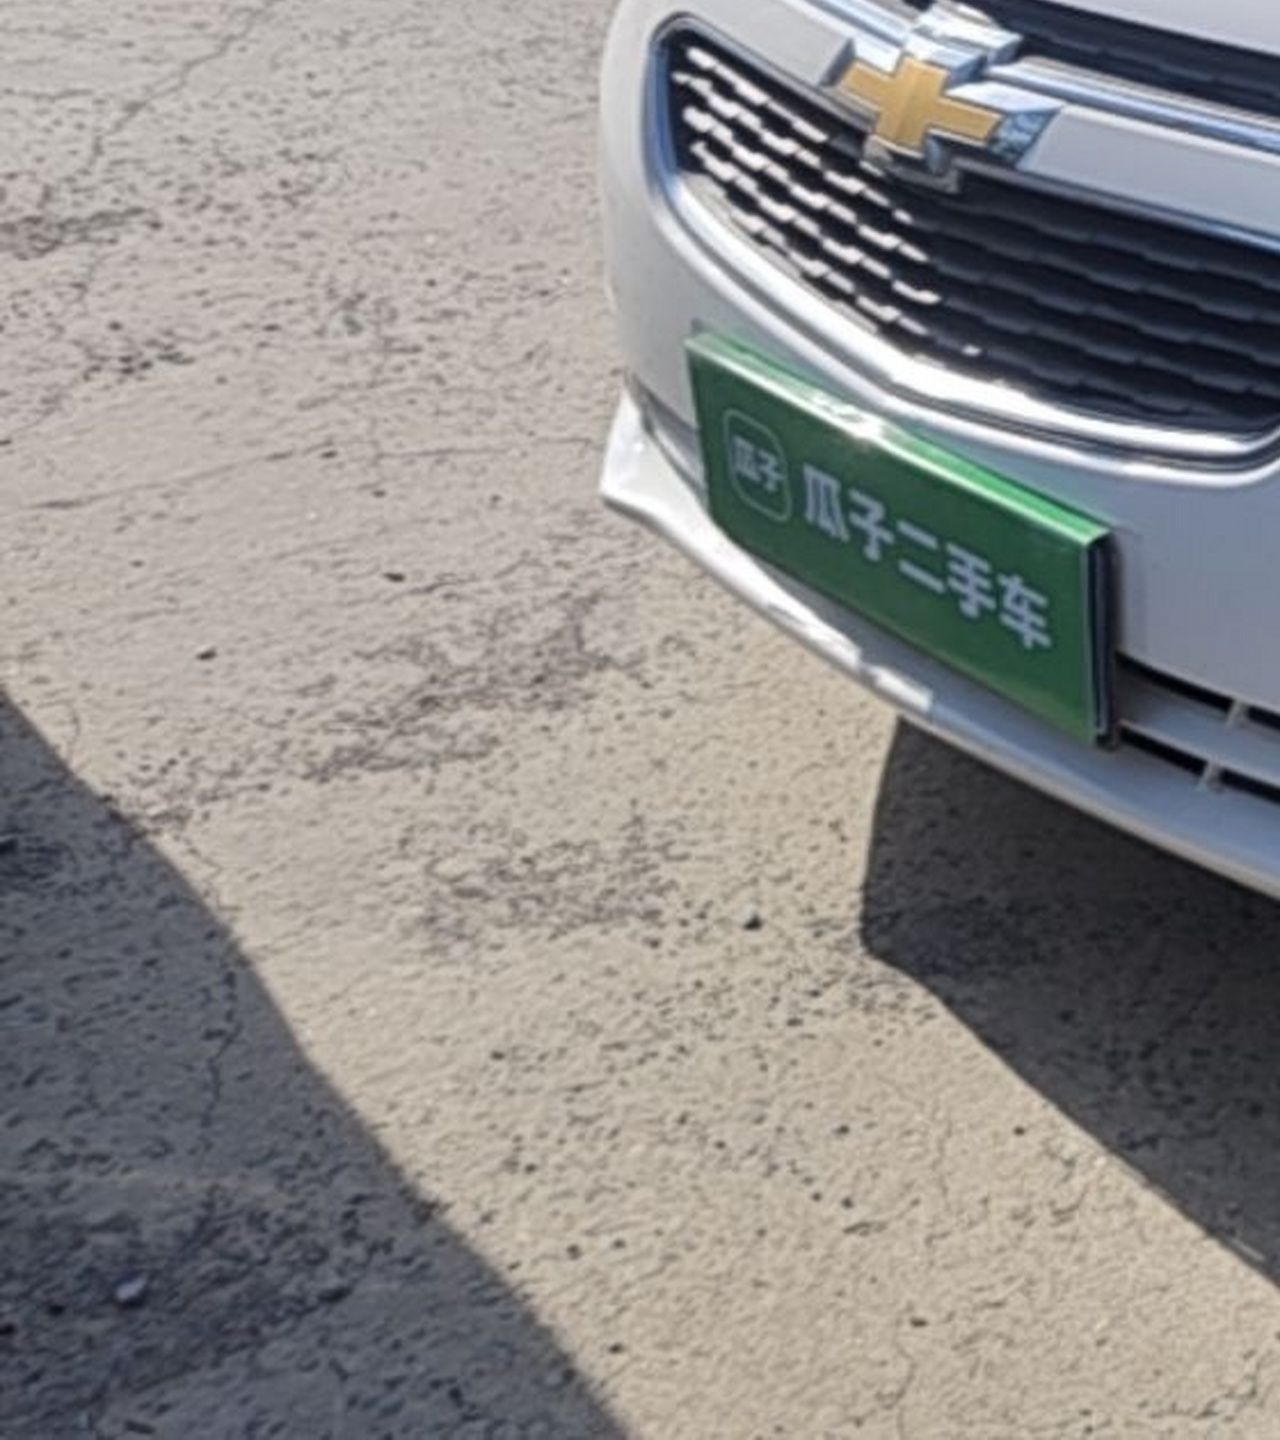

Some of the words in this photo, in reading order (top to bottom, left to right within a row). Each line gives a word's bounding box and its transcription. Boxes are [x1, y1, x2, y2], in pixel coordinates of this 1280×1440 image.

[732, 435, 787, 492] 瓜子
[803, 462, 1052, 650] 瓜子二手车
